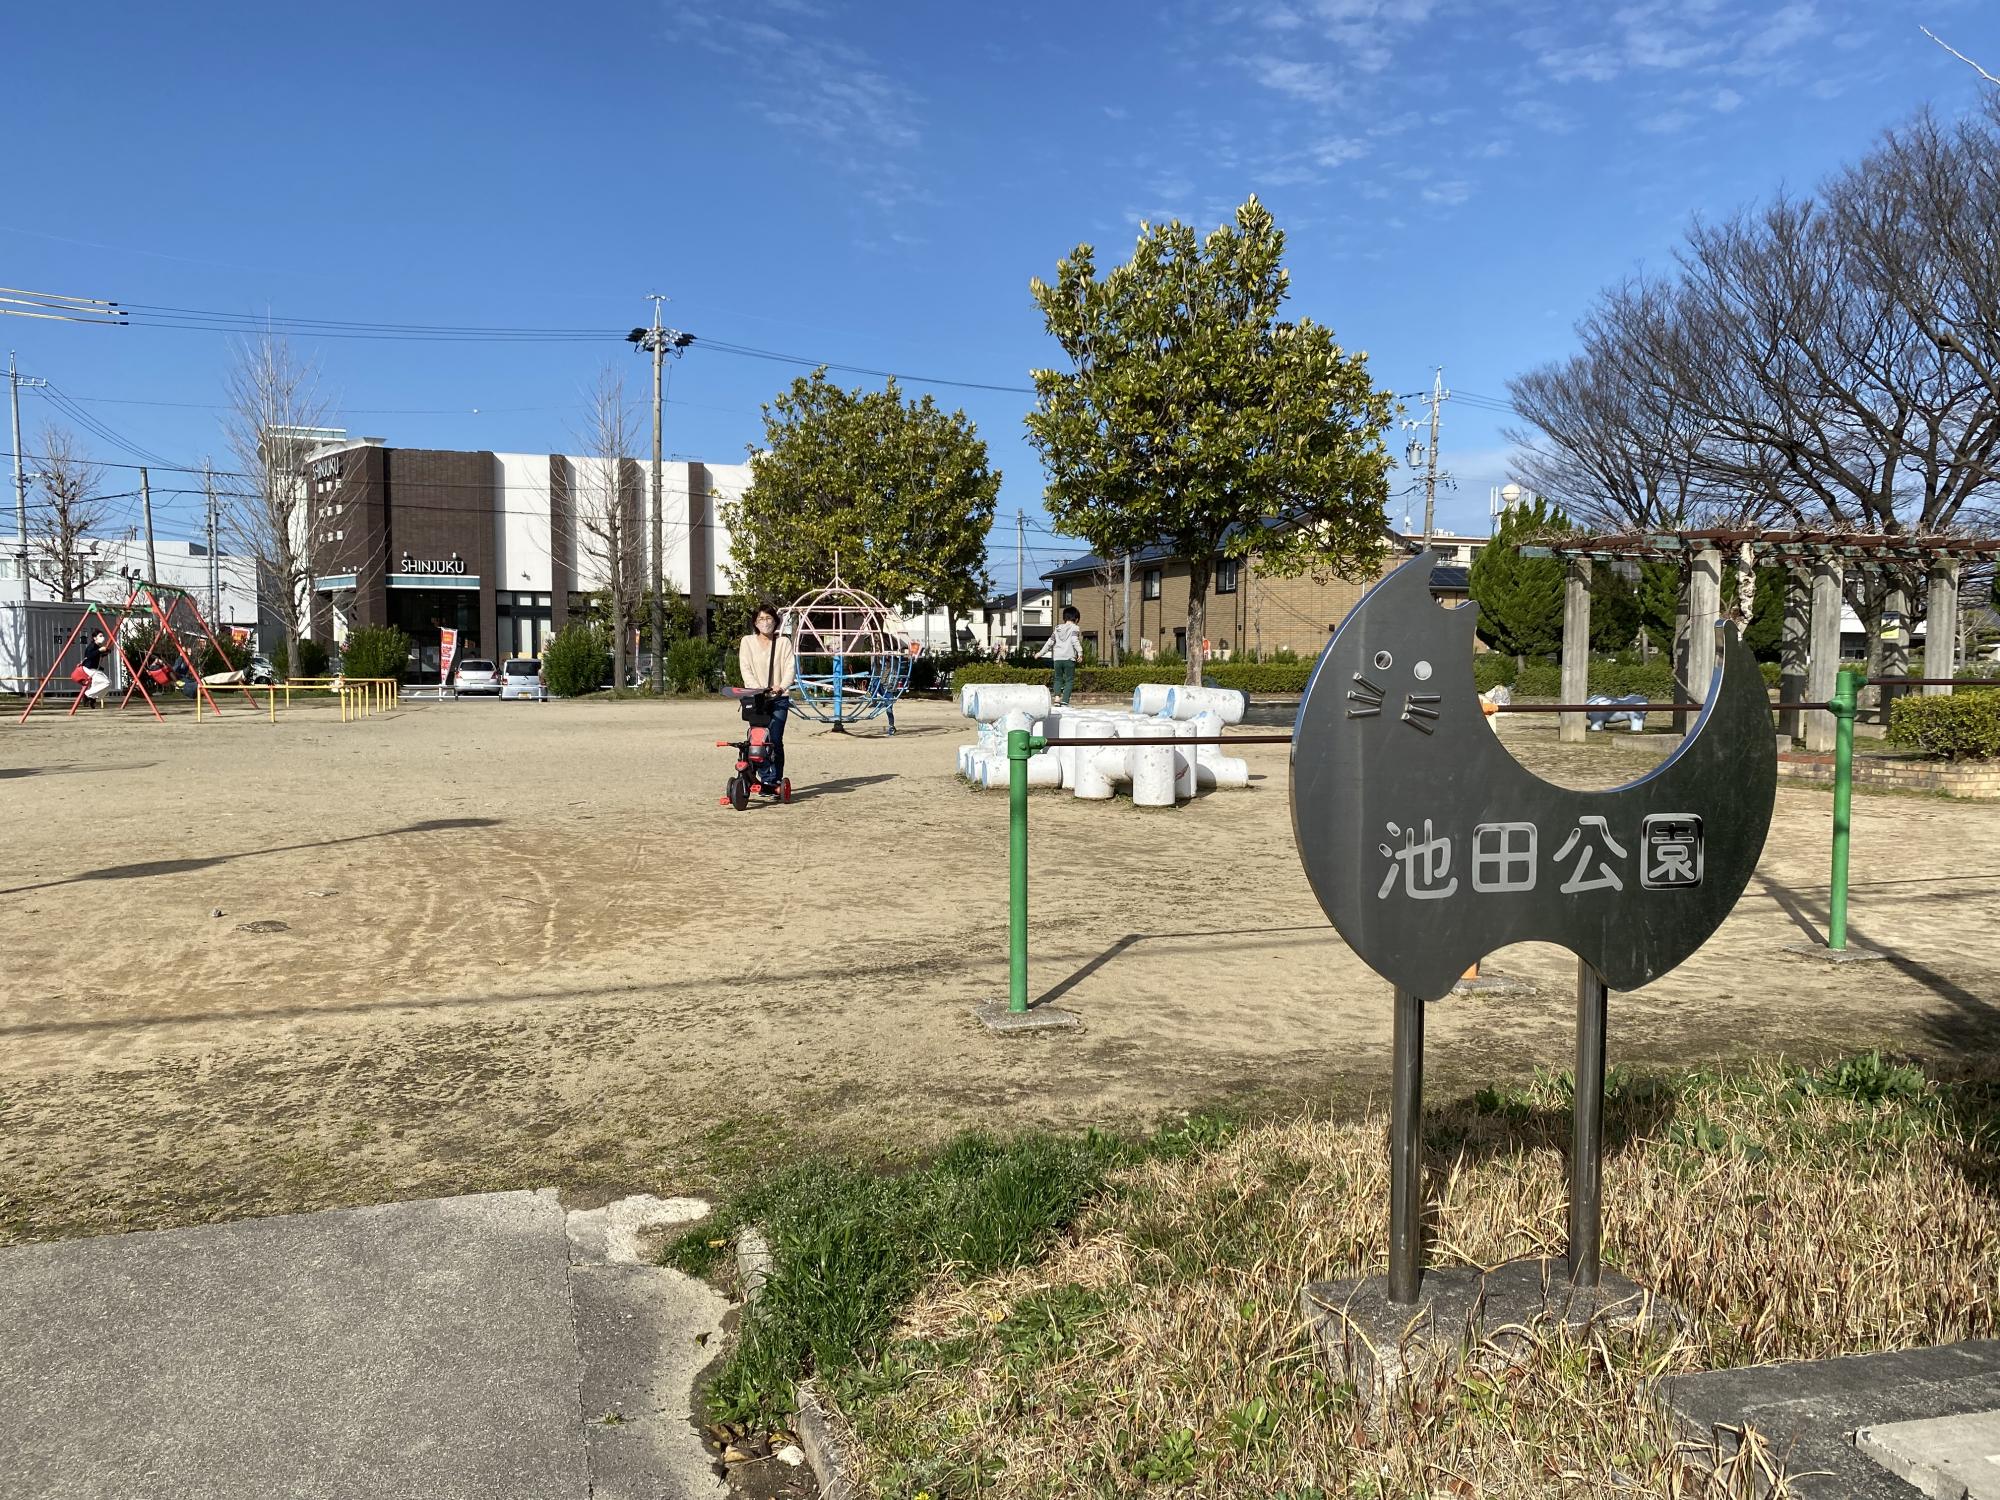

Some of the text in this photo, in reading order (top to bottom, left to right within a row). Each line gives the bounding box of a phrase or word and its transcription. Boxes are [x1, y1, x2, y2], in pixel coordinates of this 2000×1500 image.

[401, 559, 465, 573] SHINJUKU
[1378, 812, 1704, 900] 池田公園
